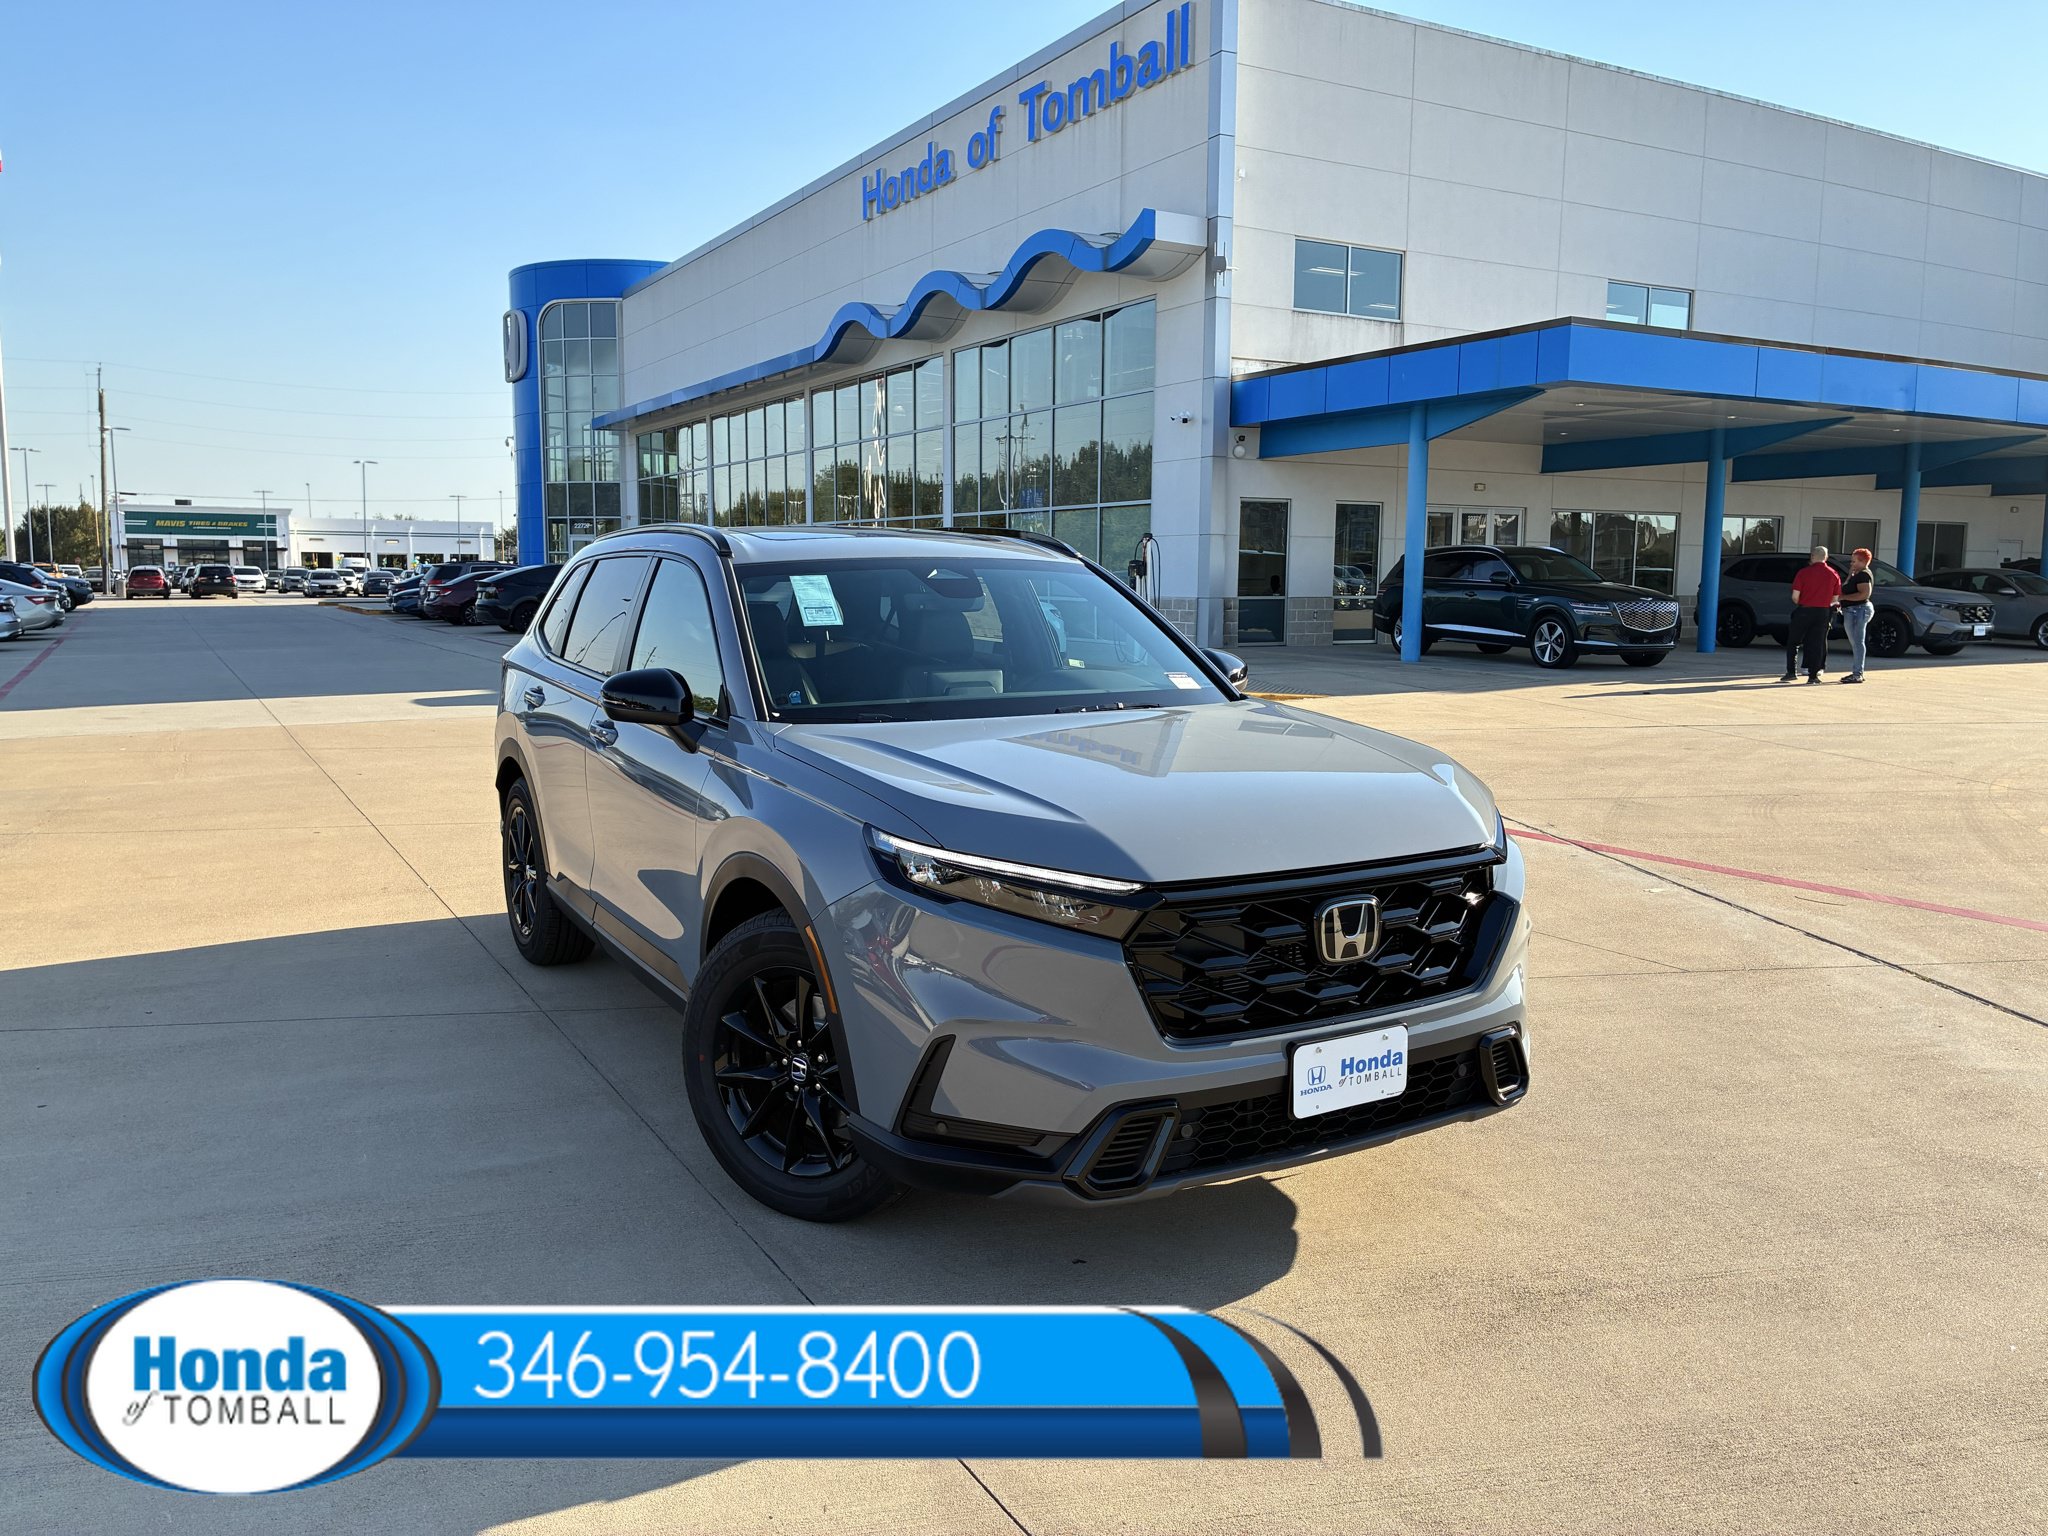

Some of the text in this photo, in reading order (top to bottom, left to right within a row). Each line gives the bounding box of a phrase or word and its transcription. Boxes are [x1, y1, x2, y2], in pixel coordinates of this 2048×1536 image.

[862, 1, 1196, 221] Honda of Tomball
[1340, 1049, 1403, 1077] Honda
[1338, 1067, 1402, 1087] of TOMBALL
[1300, 1084, 1333, 1096] HONDA
